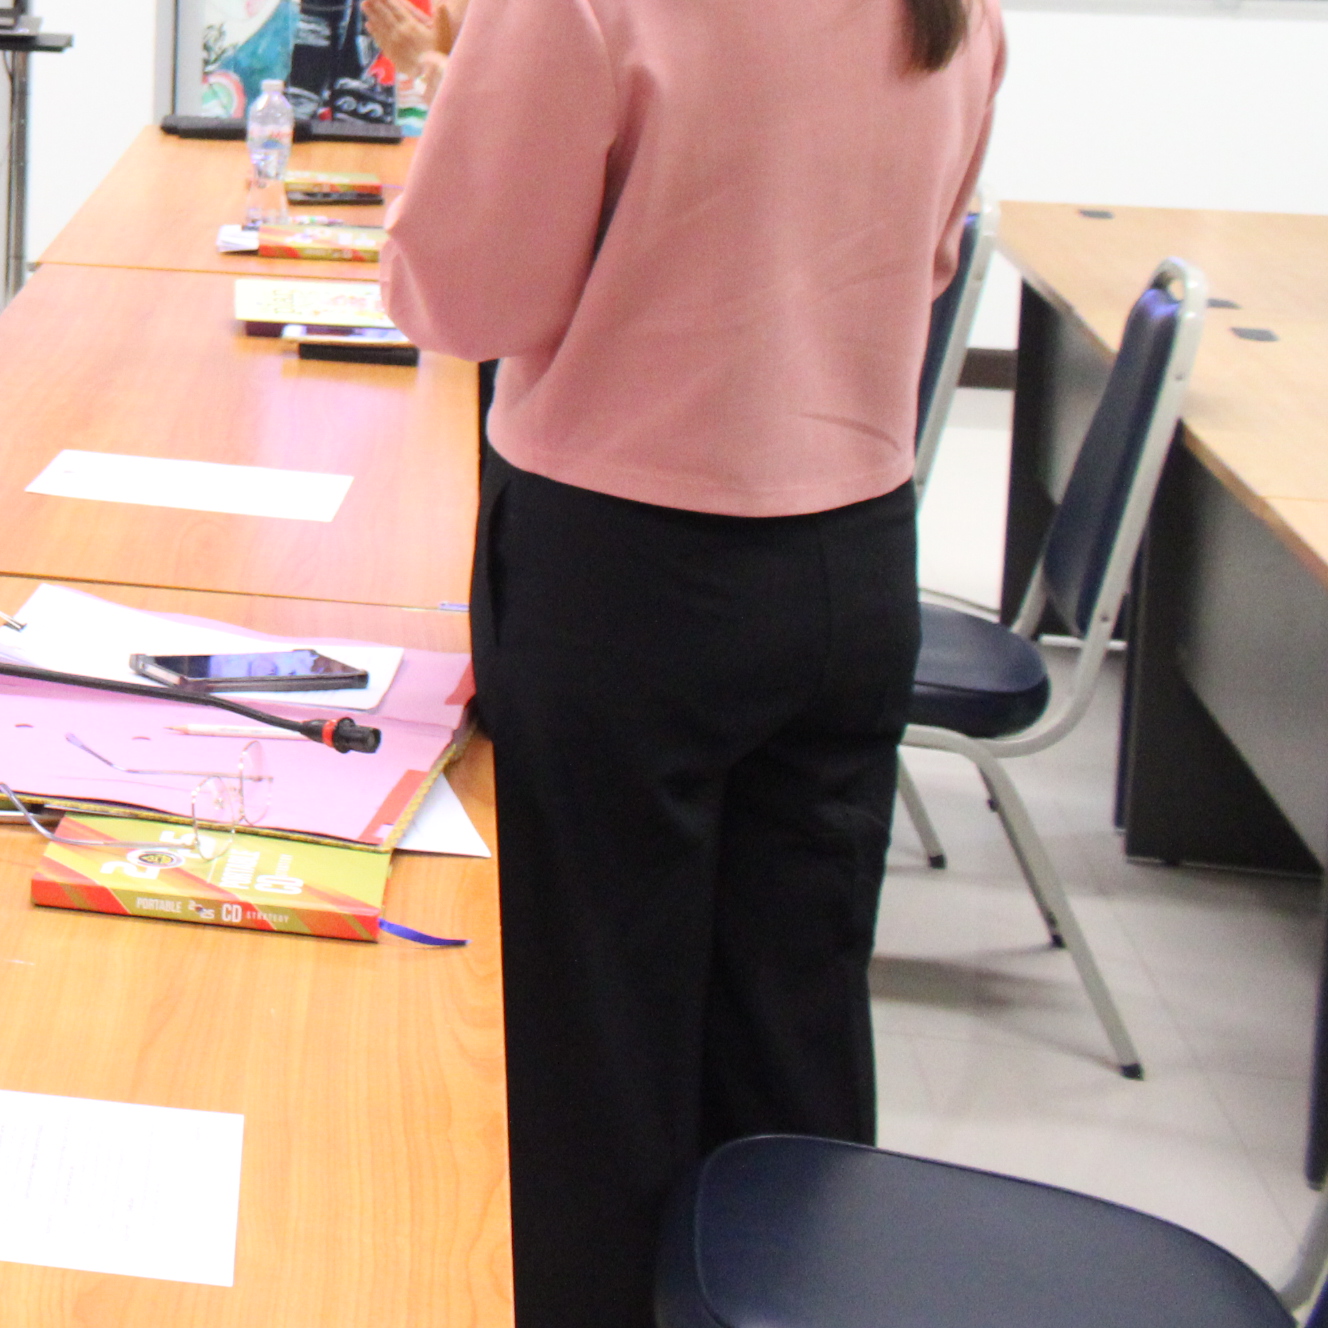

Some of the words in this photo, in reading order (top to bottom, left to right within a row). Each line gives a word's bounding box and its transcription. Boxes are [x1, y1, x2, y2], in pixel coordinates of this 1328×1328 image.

[219, 848, 261, 890] PORTABLE
[254, 874, 304, 895] CD
[136, 897, 183, 913] PORTABLE
[221, 902, 243, 923] CD
[246, 911, 290, 923] STRATEGY
